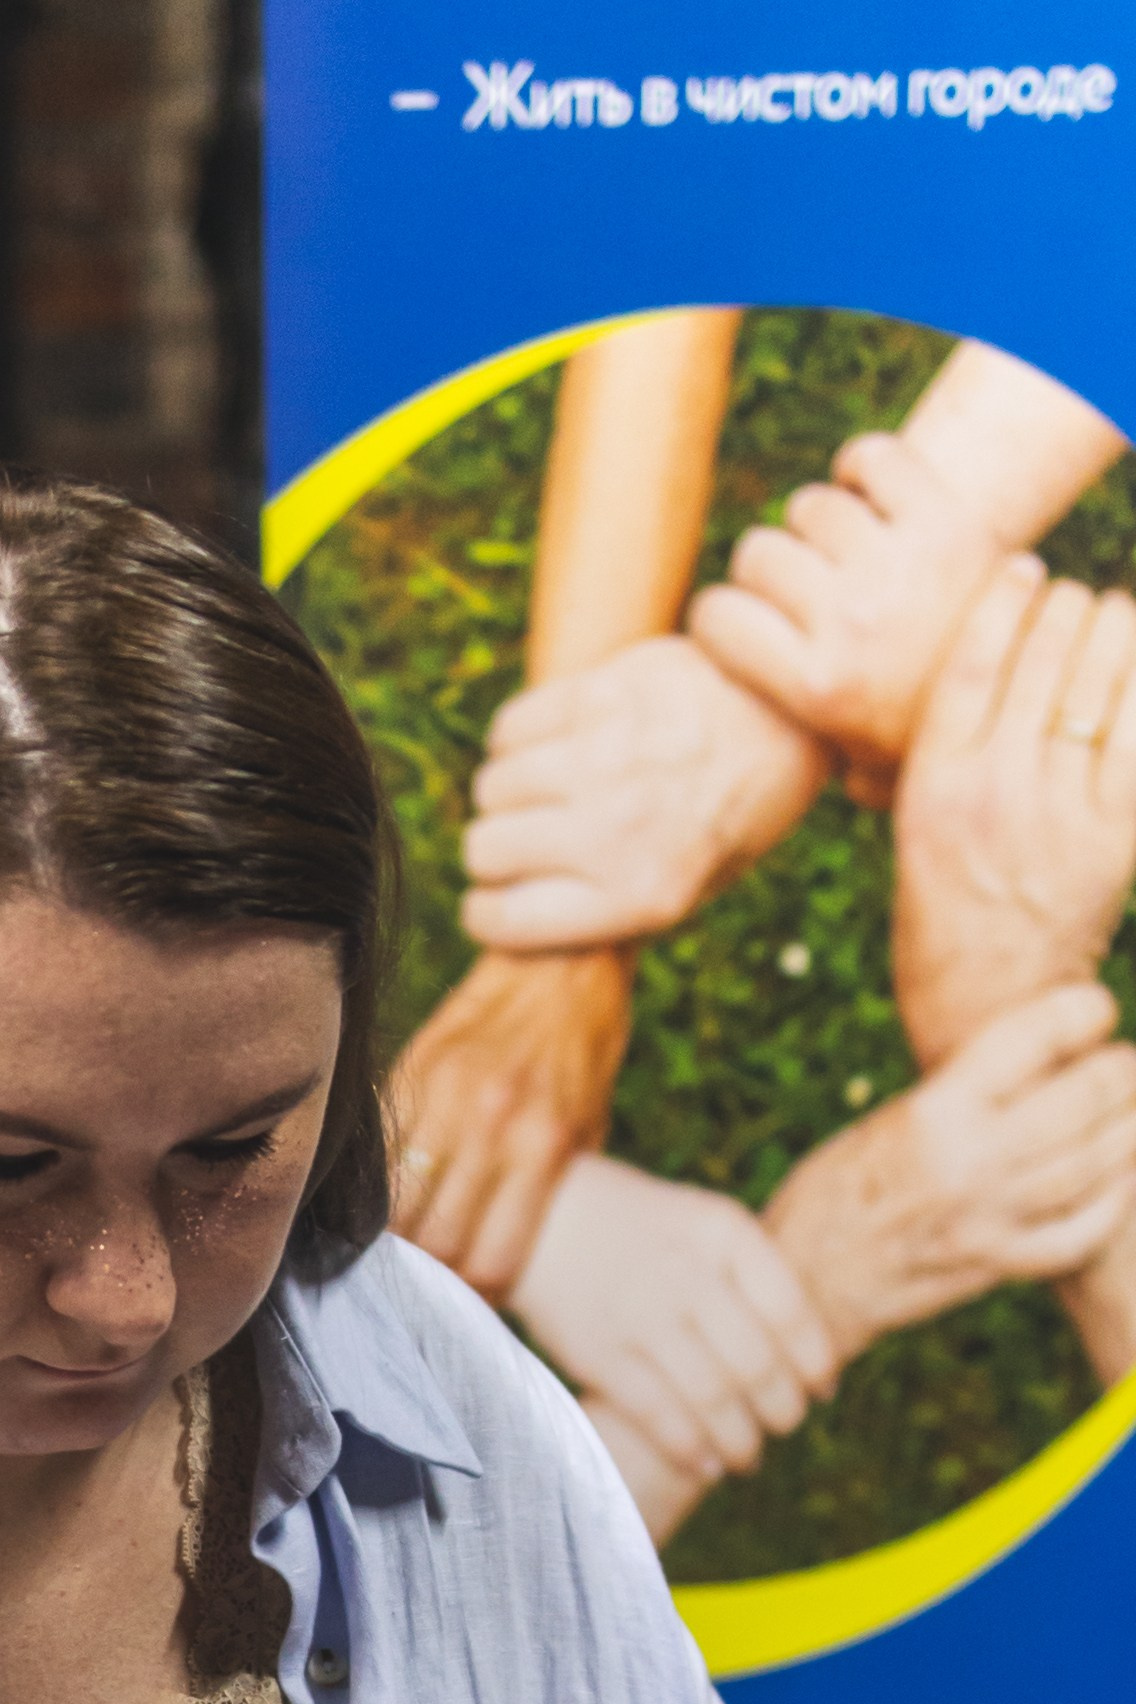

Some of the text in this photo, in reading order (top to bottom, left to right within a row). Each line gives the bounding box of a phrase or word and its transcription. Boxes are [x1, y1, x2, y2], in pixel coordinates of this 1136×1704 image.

[461, 59, 634, 131] Жить
[640, 74, 679, 127] в
[684, 71, 898, 124] чистом
[906, 62, 1118, 131] городе
